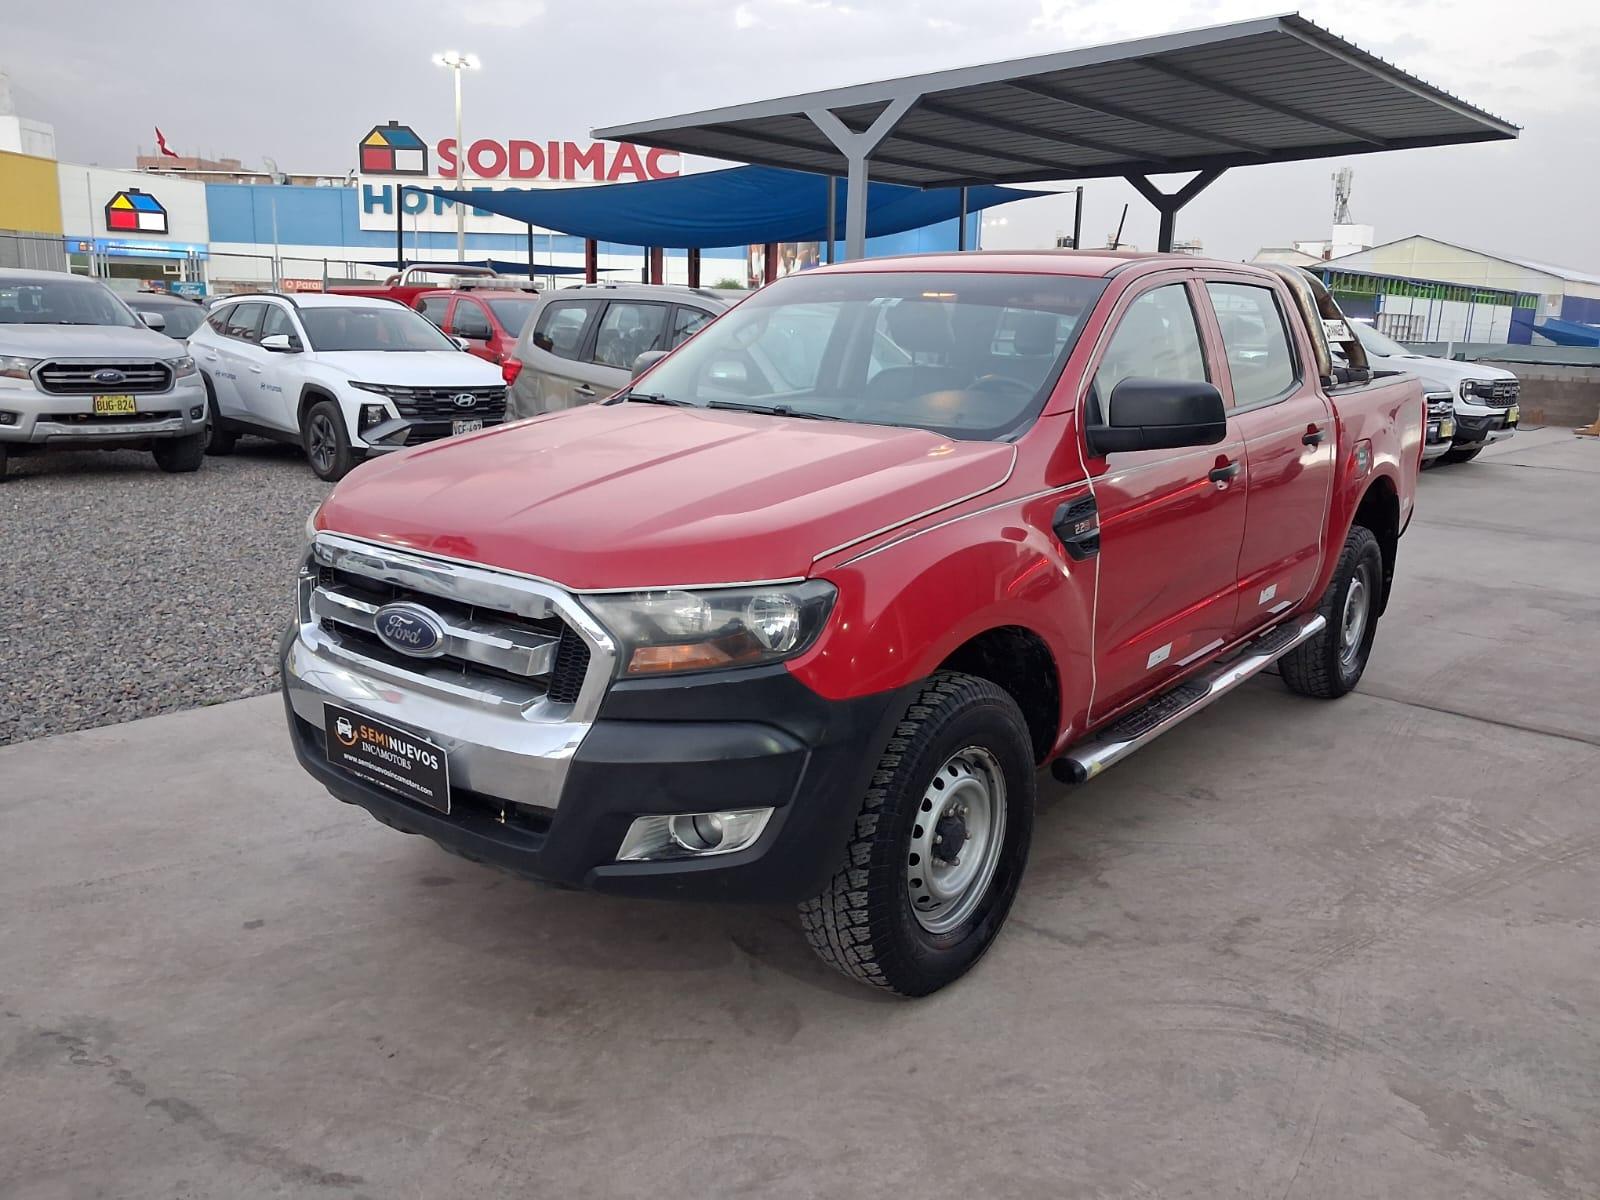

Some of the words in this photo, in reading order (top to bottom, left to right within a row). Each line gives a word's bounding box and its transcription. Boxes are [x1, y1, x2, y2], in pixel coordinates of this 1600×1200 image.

[438, 138, 680, 181] SODIMAC
[97, 400, 133, 411] BUG-824
[385, 615, 421, 644] Ford
[362, 742, 412, 770] INCAMOTORS
